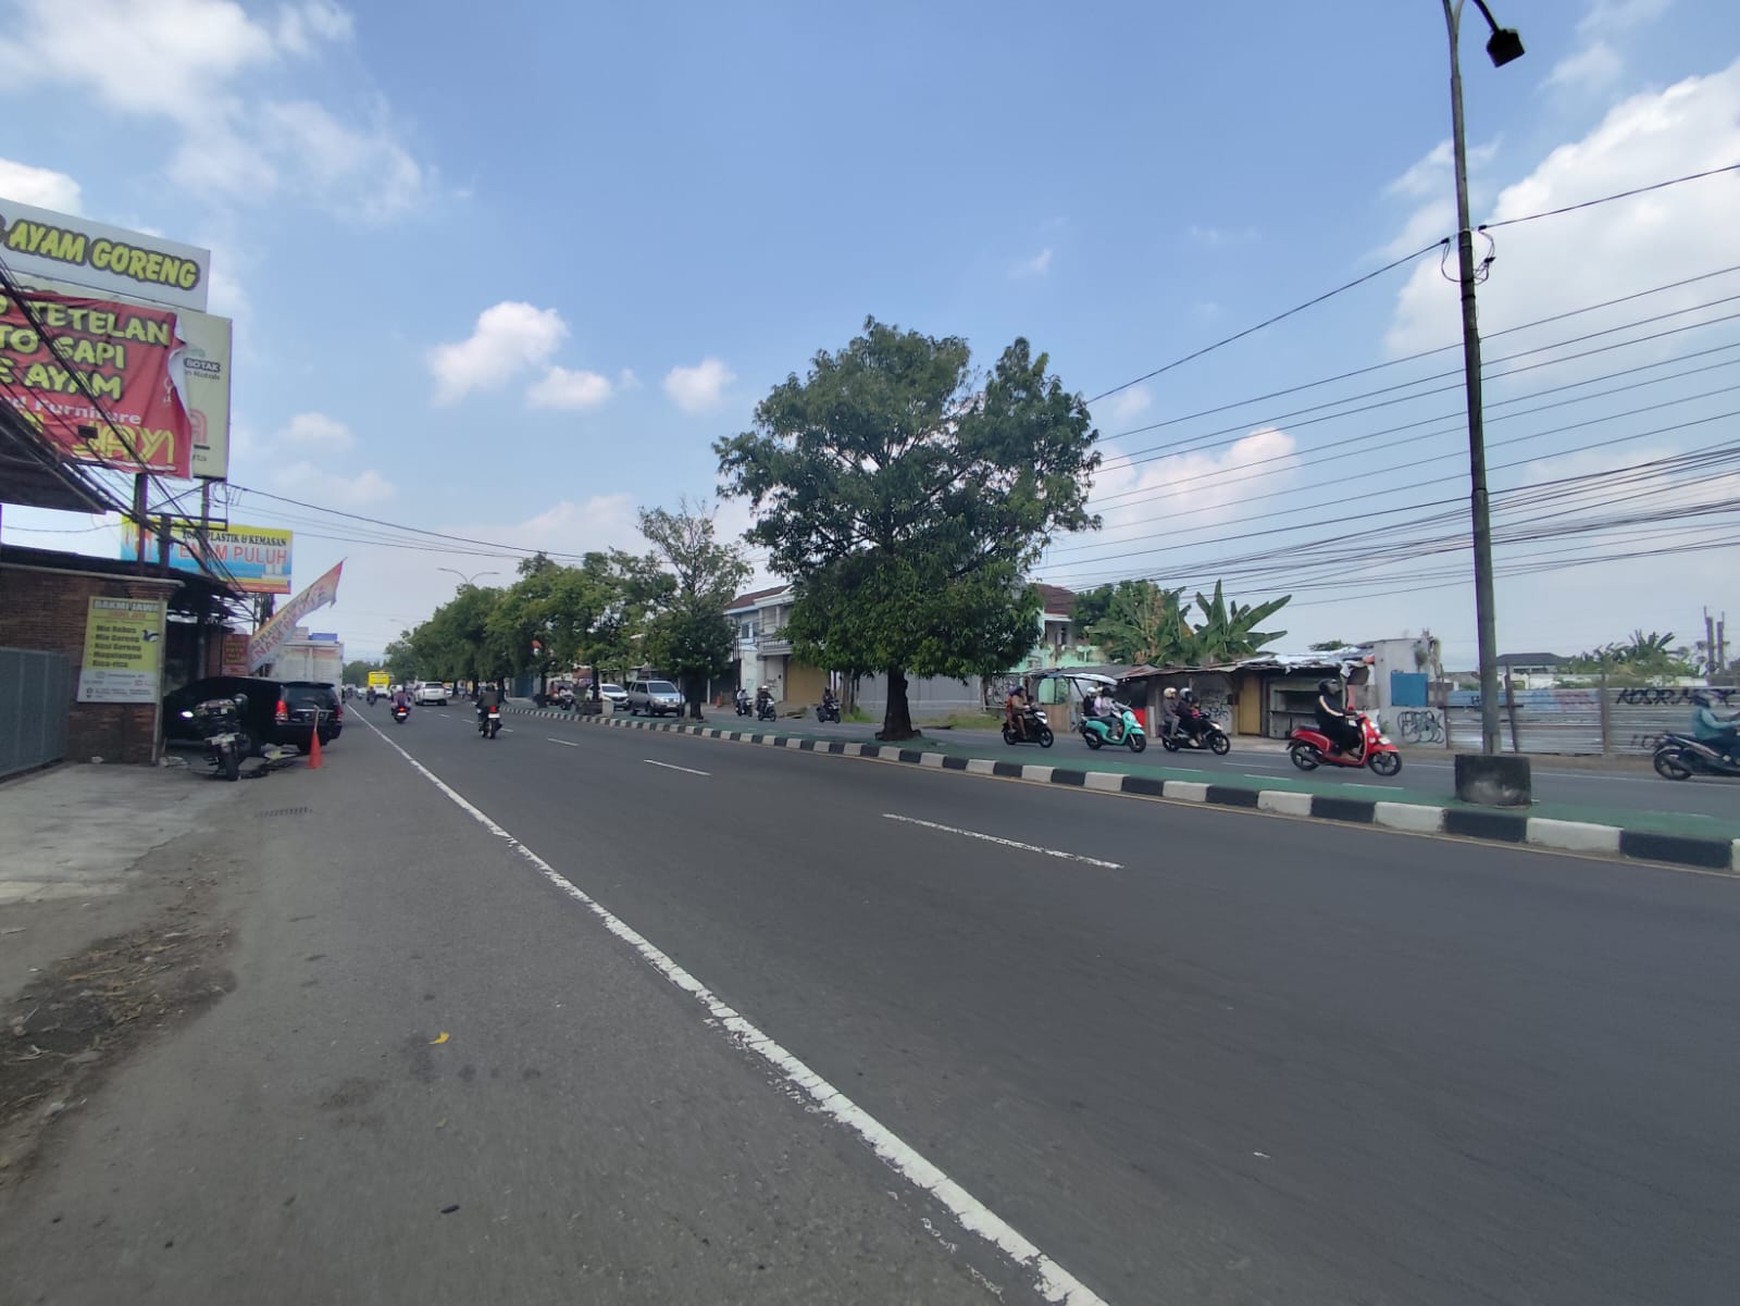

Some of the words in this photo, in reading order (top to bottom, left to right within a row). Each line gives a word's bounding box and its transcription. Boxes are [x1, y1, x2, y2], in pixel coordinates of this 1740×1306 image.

[6, 220, 88, 265] AYAM
[91, 240, 199, 289] GORENG
[27, 300, 169, 346] TETELAN
[53, 335, 125, 370] SAPI
[184, 358, 221, 373] BOTAK
[23, 362, 122, 400] AYAM
[35, 402, 142, 424] Furniure
[179, 541, 228, 561] ENM
[234, 546, 288, 565] PULUH
[248, 535, 287, 547] KEMASAN
